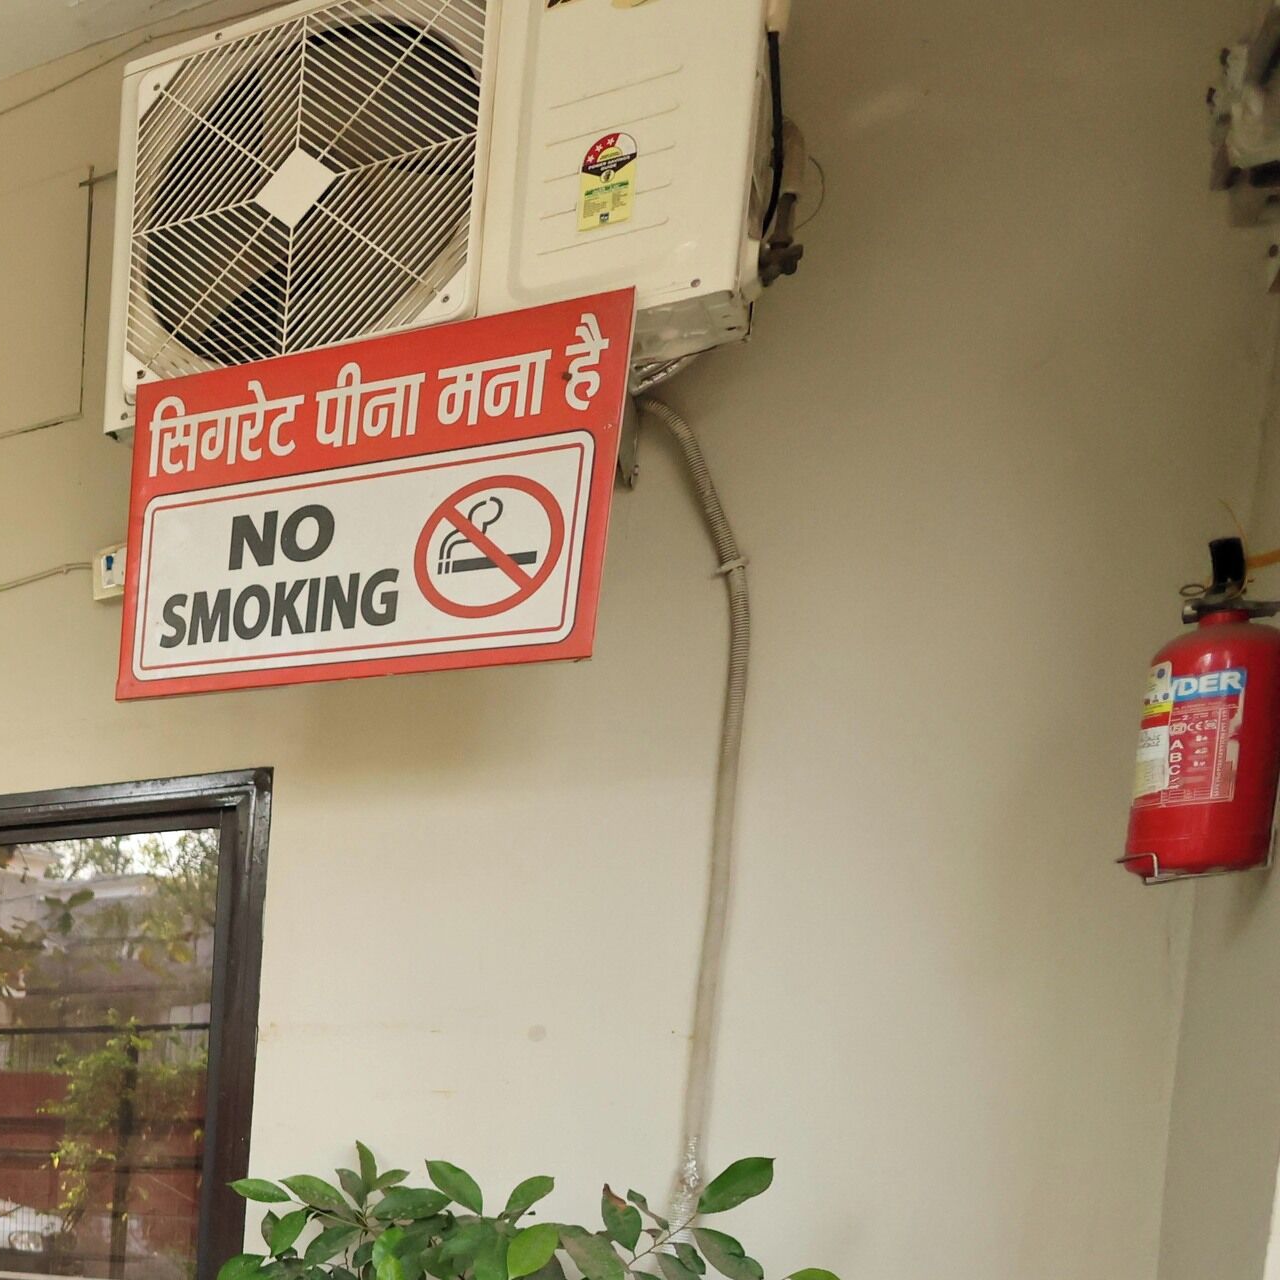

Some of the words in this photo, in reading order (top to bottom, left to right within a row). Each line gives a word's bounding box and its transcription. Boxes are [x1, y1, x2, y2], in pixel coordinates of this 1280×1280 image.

[148, 380, 305, 478] सिगरेट
[316, 362, 426, 448] पीना
[437, 349, 553, 426] मना
[564, 313, 610, 412] है
[228, 503, 335, 571] NO
[159, 568, 400, 649] SMOKING
